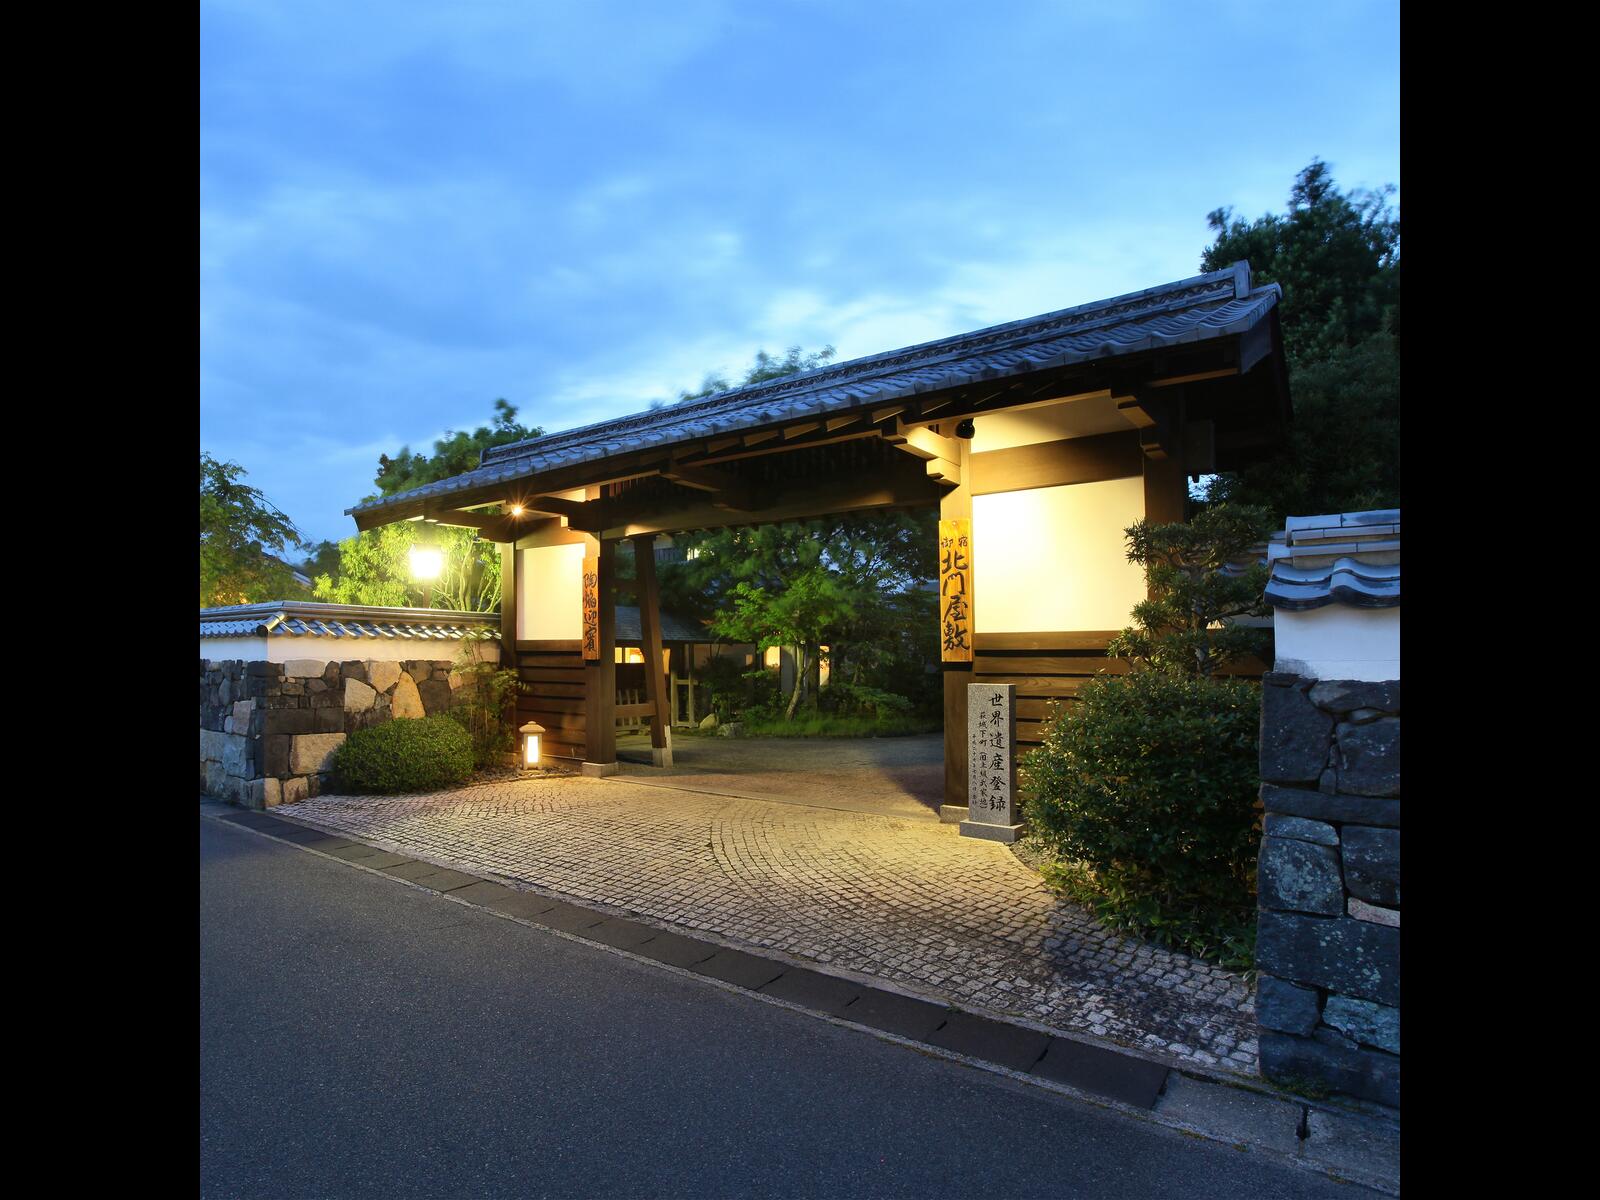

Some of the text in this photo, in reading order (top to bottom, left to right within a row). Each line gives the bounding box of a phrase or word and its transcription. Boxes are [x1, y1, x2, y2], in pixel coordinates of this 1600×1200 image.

[942, 549, 970, 652] 北門屋敷
[989, 693, 1006, 811] 世界遺産登録
